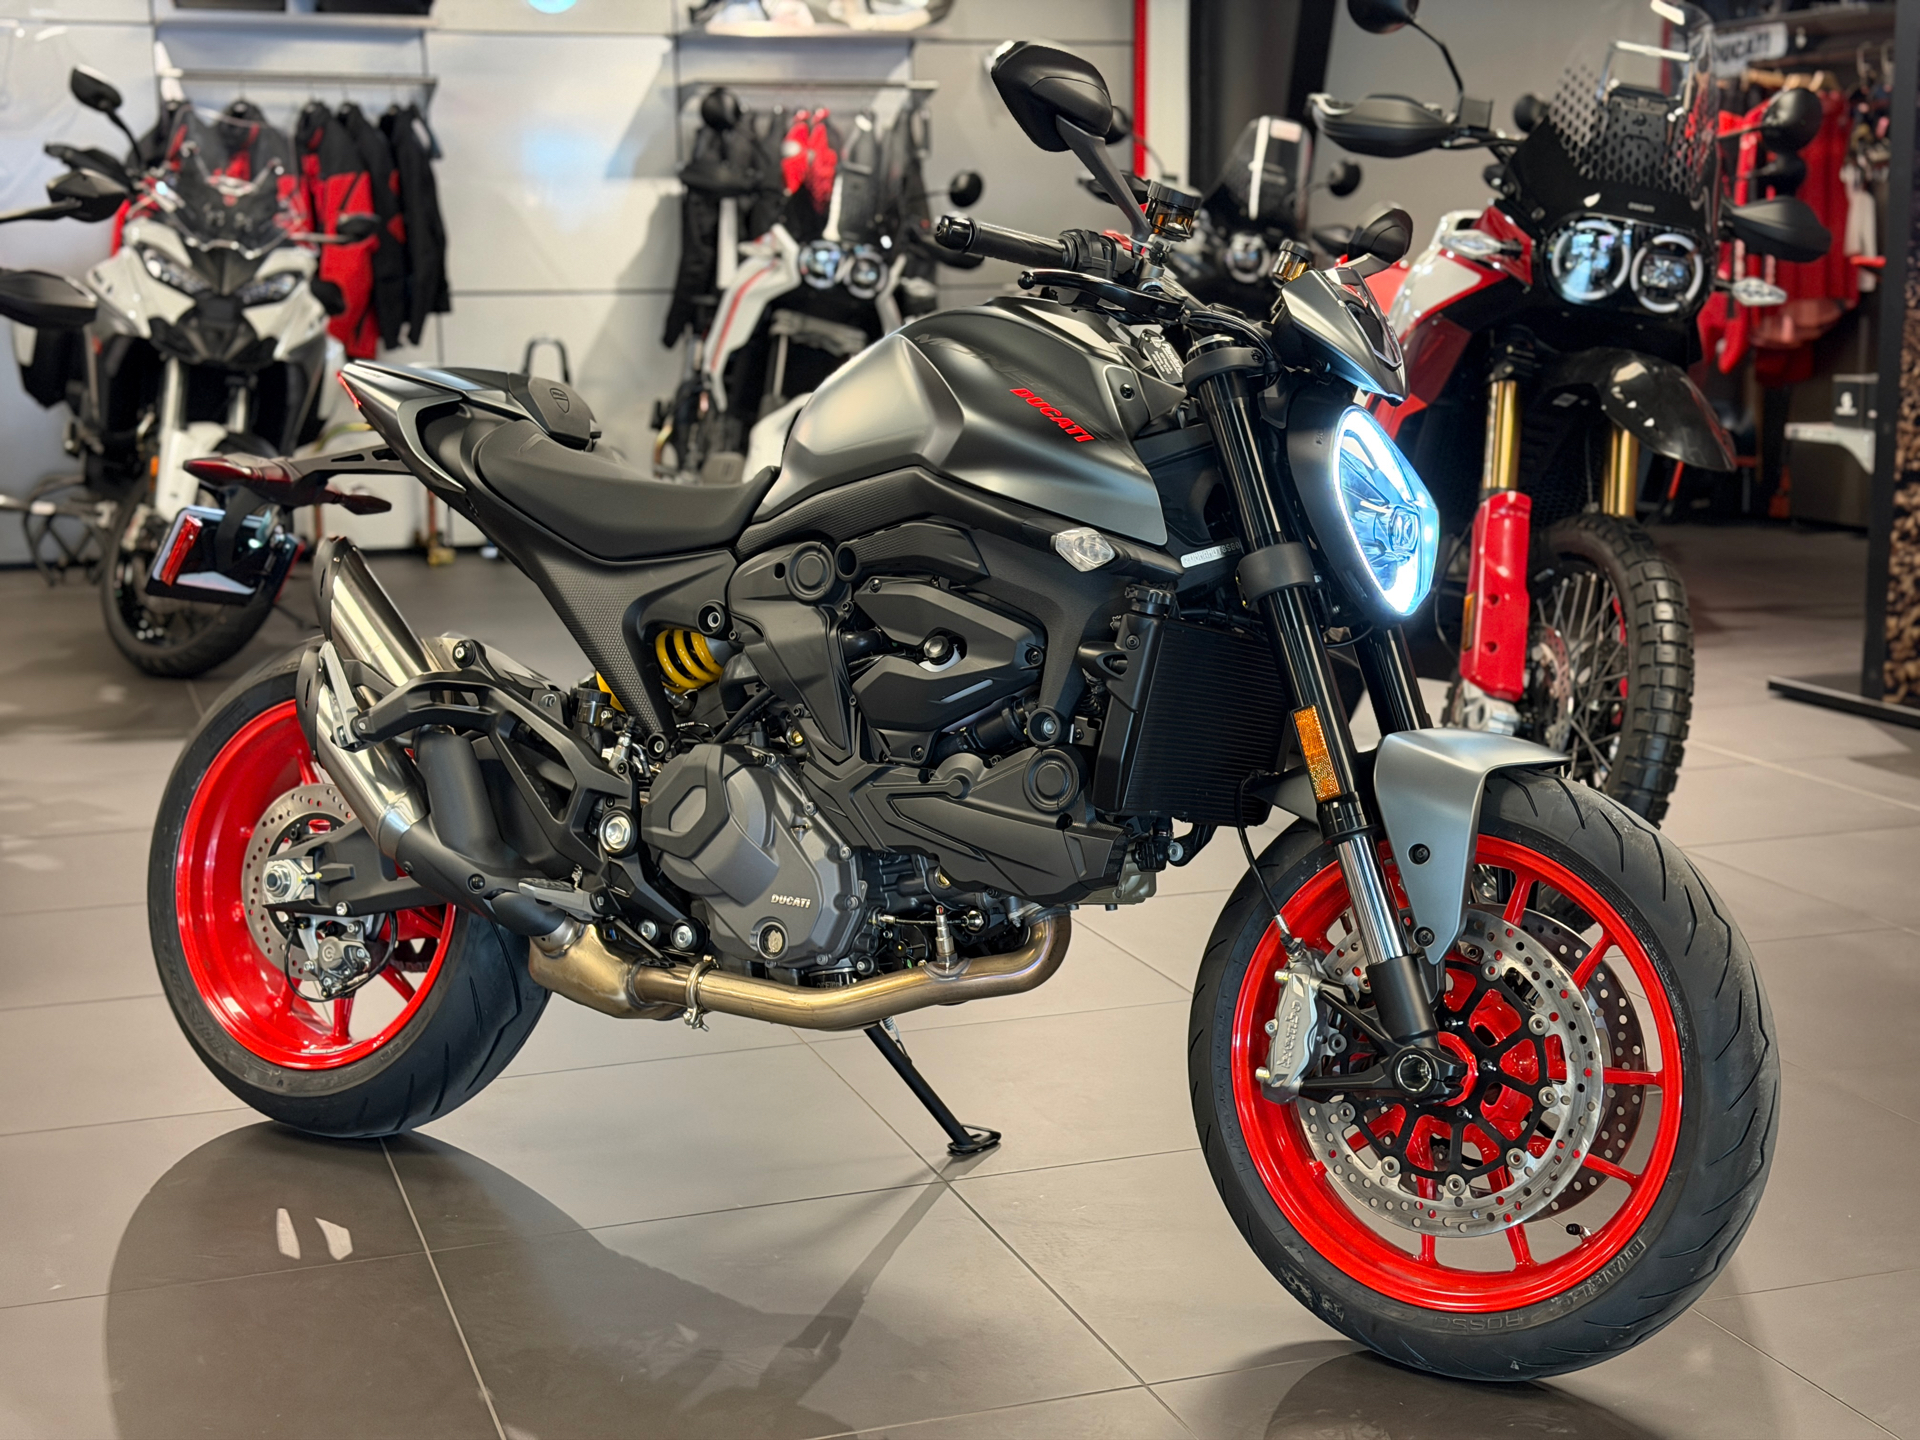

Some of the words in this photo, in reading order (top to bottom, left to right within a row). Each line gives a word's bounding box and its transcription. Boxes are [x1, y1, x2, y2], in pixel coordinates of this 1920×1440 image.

[1010, 388, 1094, 442] DUCATI
[771, 894, 811, 908] DUCATI
[1276, 1000, 1301, 1069] brembo
